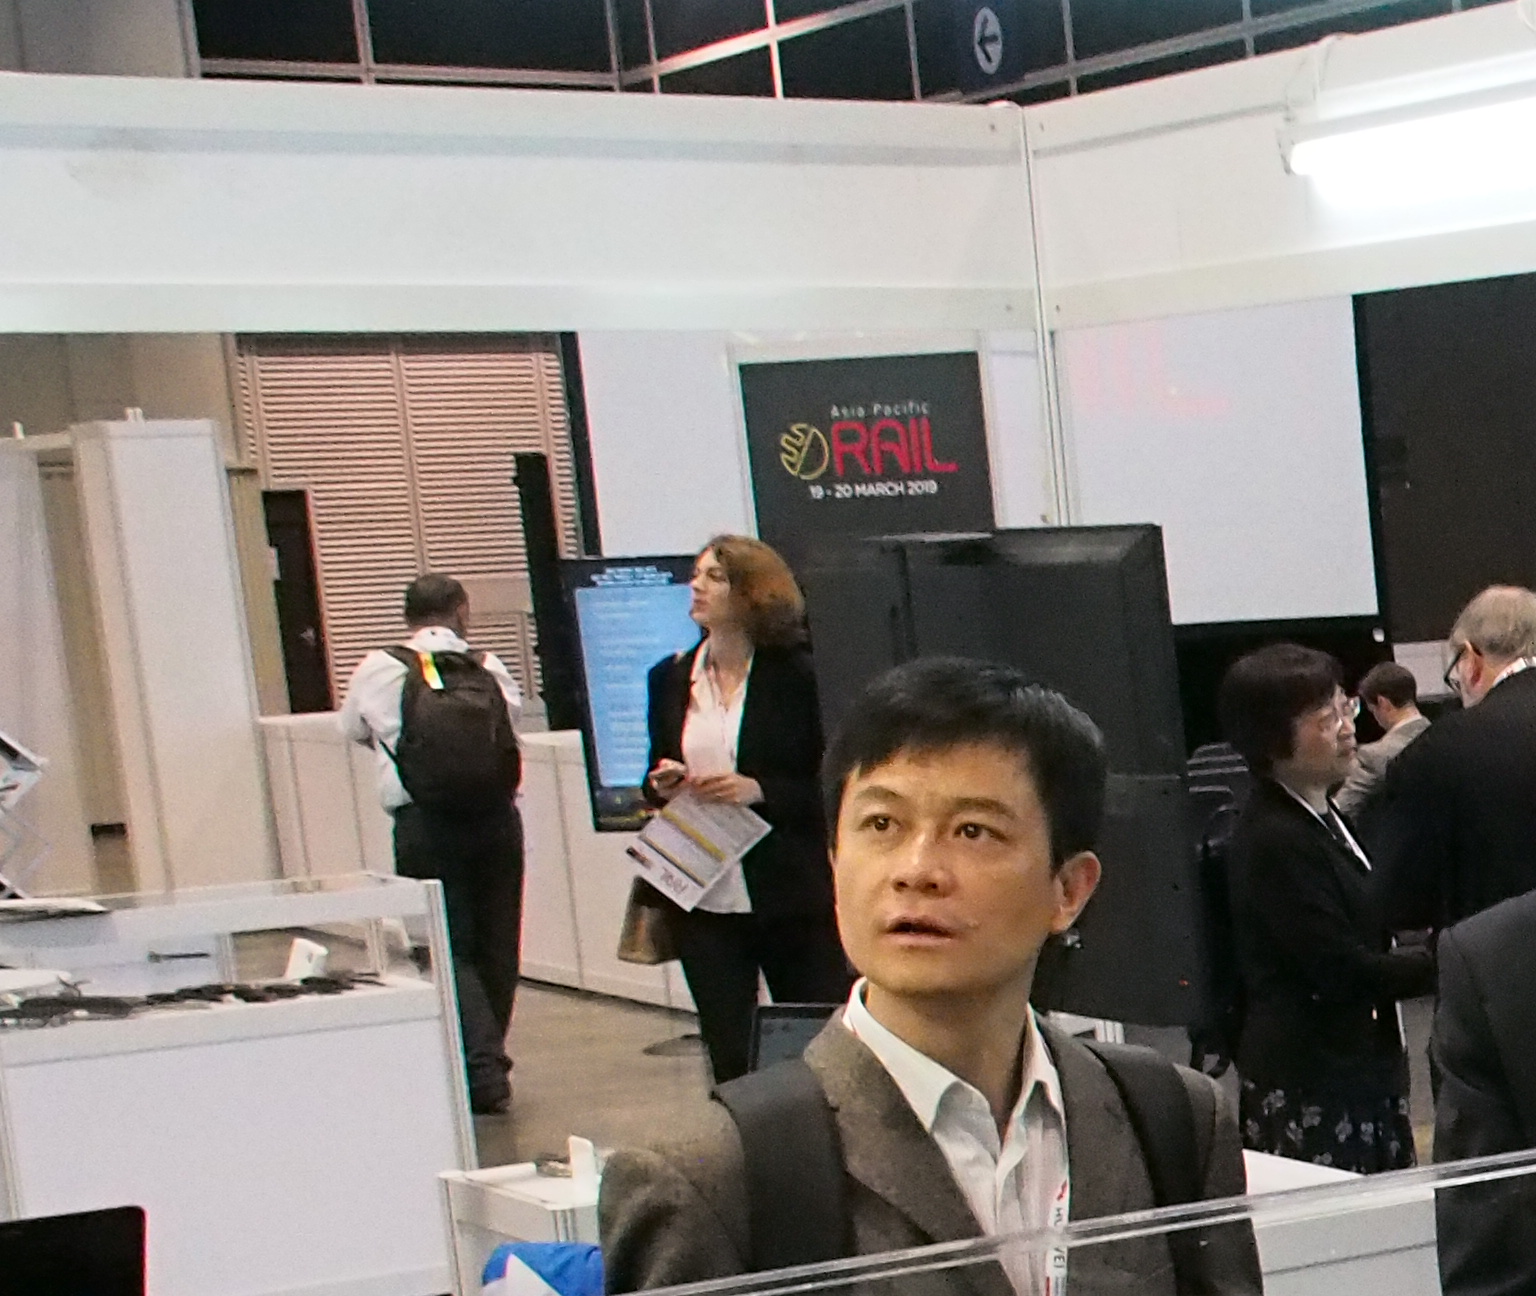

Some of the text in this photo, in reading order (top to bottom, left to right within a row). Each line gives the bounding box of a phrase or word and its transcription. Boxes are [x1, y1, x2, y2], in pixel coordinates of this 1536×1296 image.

[830, 400, 930, 418] Asia Pacific
[831, 416, 961, 477] RAIL
[834, 483, 852, 499] 20
[855, 481, 905, 498] MARCH
[907, 479, 939, 496] 2019
